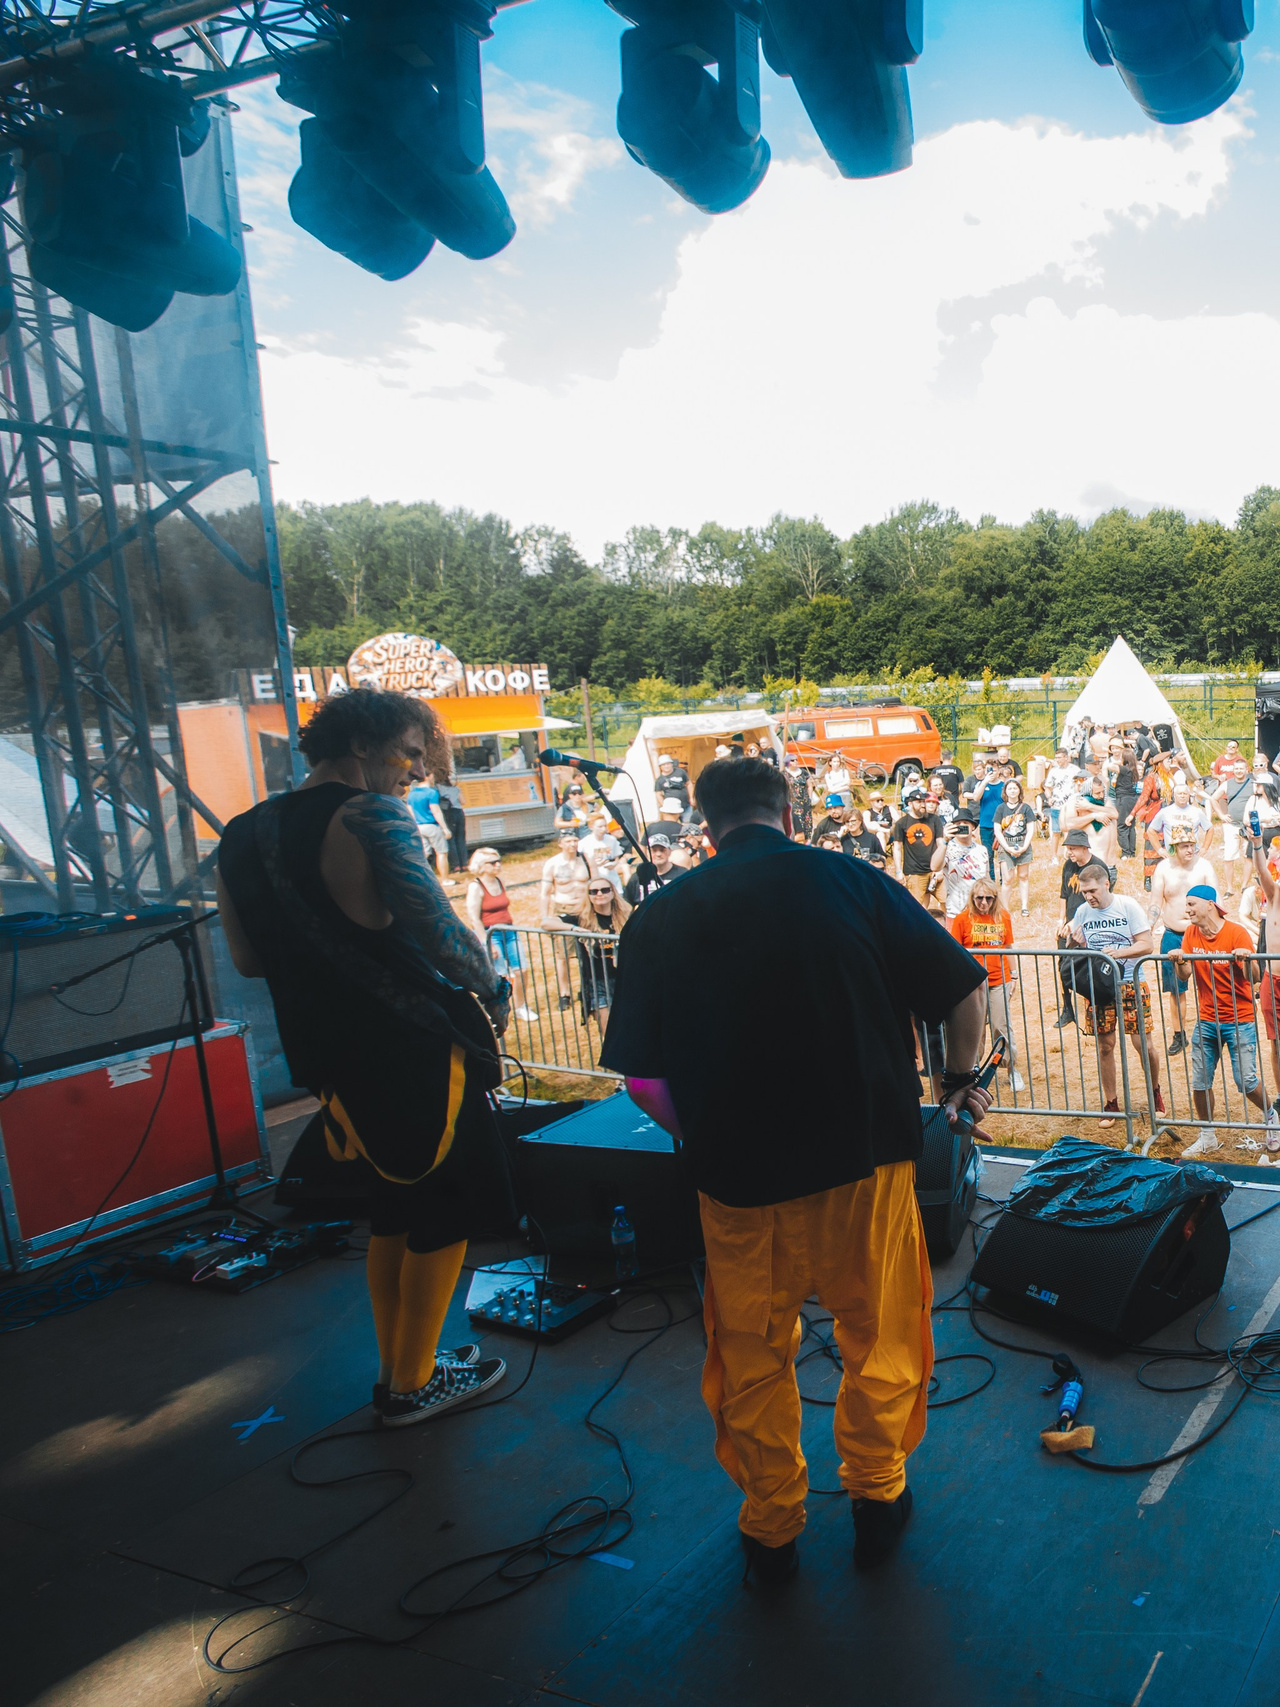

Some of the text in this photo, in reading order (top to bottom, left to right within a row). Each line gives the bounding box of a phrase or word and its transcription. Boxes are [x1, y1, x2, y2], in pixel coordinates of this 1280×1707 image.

[373, 641, 433, 663] SUPER
[383, 656, 430, 673] HERO
[252, 673, 348, 701] ЕДА
[380, 670, 437, 691] TRUCK
[466, 669, 551, 693] КОФЕ
[1083, 917, 1128, 931] RAMONES
